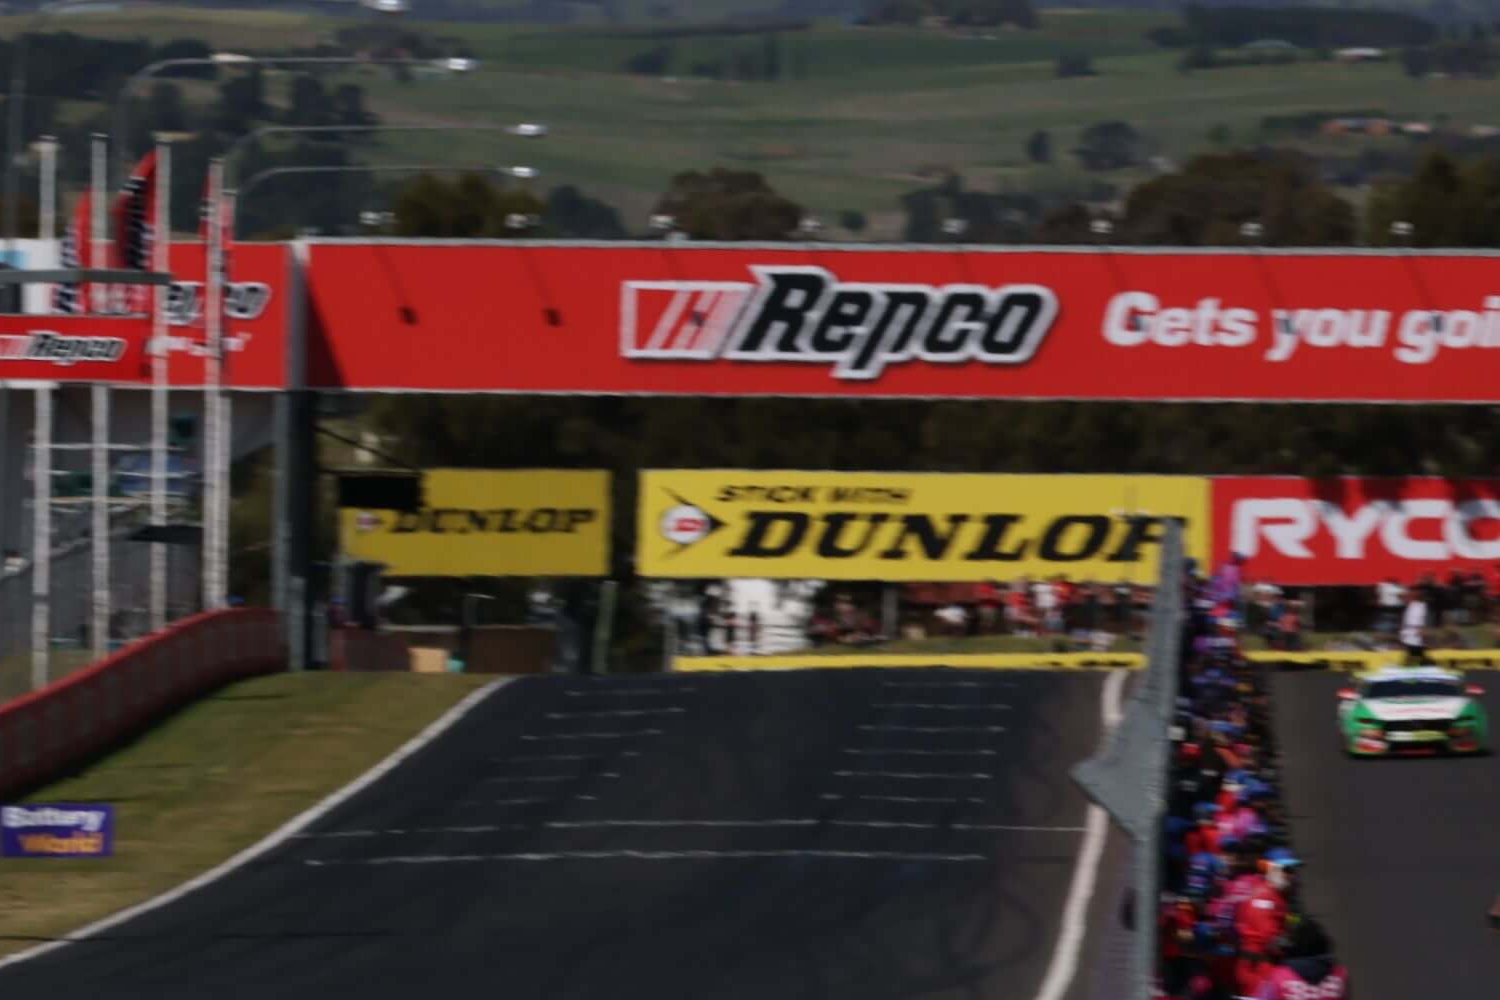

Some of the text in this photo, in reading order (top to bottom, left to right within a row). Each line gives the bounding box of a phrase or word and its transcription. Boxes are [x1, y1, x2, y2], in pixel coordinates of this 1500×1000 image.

[736, 265, 1057, 379] Repco
[1104, 291, 1258, 347] Gets
[1264, 307, 1393, 361] you
[25, 330, 128, 365] Repco
[391, 507, 597, 534] DUNLOP
[1, 806, 106, 832] Battery
[18, 831, 103, 853] World
